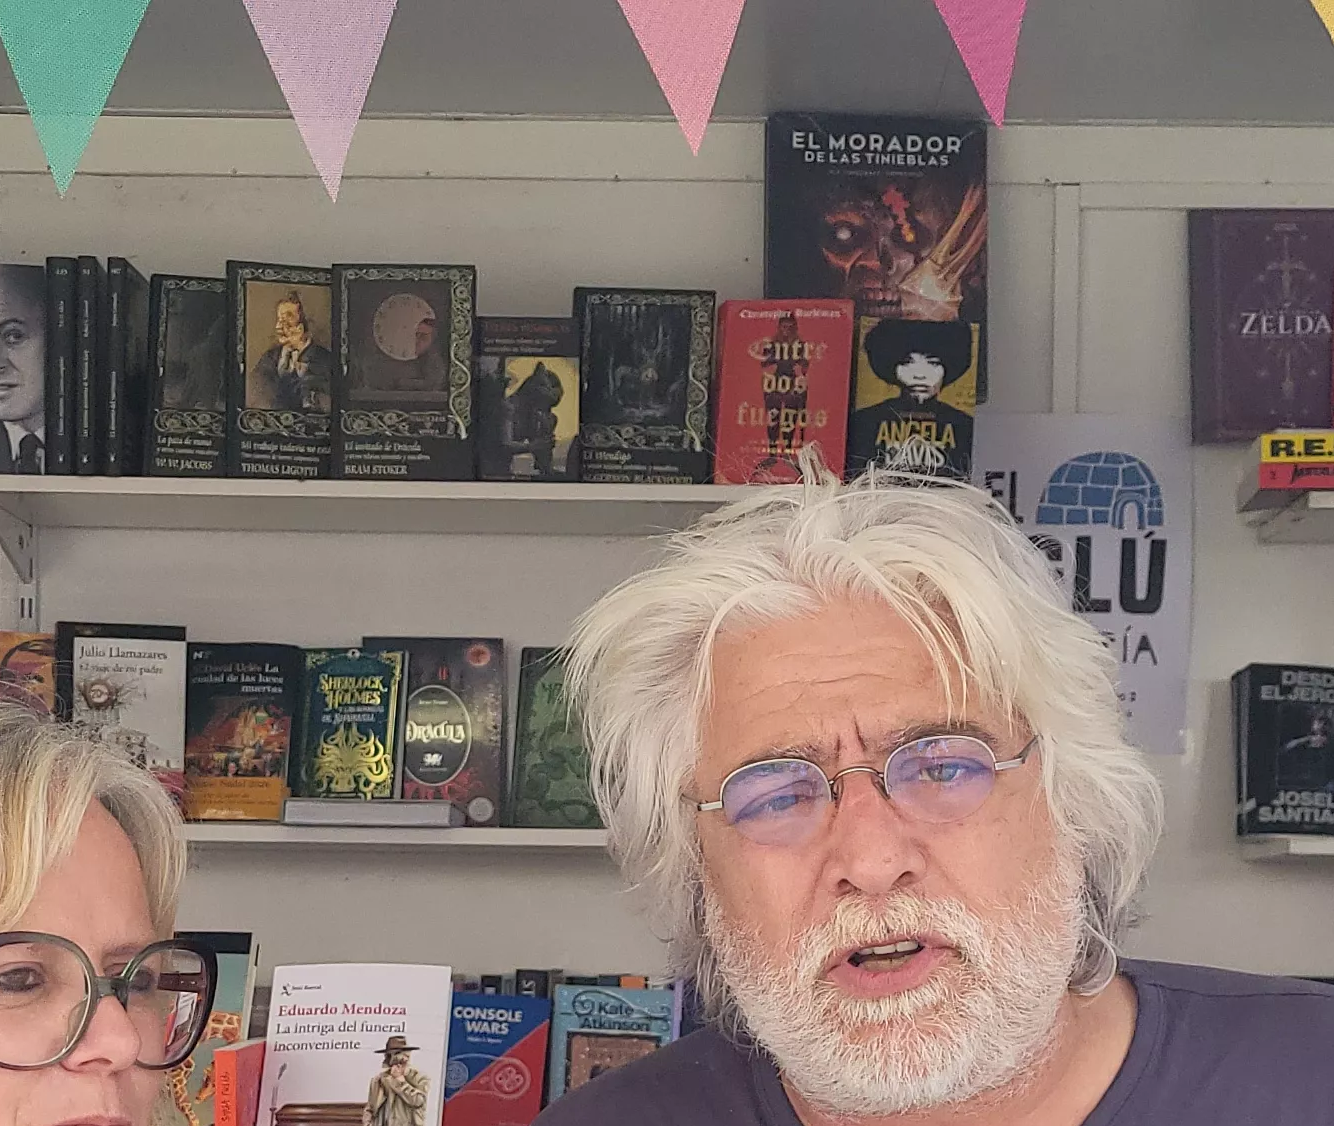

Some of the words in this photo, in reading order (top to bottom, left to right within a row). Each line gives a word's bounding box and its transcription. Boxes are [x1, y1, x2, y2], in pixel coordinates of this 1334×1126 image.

[792, 131, 820, 149] EL
[828, 133, 962, 153] MORADOR
[804, 151, 825, 162] DE
[829, 151, 861, 163] LAS
[865, 153, 949, 166] TINIEBLAS
[1240, 312, 1332, 335] ZELDA
[748, 337, 828, 361] Entre
[763, 371, 808, 393] dos
[737, 401, 828, 432] fuegos
[875, 421, 956, 448] ANGELA
[241, 462, 280, 475] THOMAS
[345, 464, 371, 475] BRAM
[372, 464, 408, 475] STOKER
[79, 646, 105, 659] Julio
[109, 646, 168, 660] Llamazares
[265, 663, 279, 673] La
[319, 674, 388, 692] SHERLOCK
[325, 690, 381, 709] HOLMES
[1261, 684, 1284, 700] EL
[406, 721, 466, 743] DRACULA
[278, 1003, 338, 1017] Eduardo
[342, 1003, 407, 1016] Mendoza
[453, 1006, 523, 1023] CONSOLE
[599, 1001, 634, 1016] Kate
[276, 1023, 291, 1034] La
[294, 1022, 335, 1036] intriga
[338, 1021, 357, 1033] del
[360, 1021, 406, 1033] funeral
[465, 1021, 510, 1035] WARS
[579, 1018, 649, 1031] Atkinson
[274, 1040, 361, 1052] inconveniente
